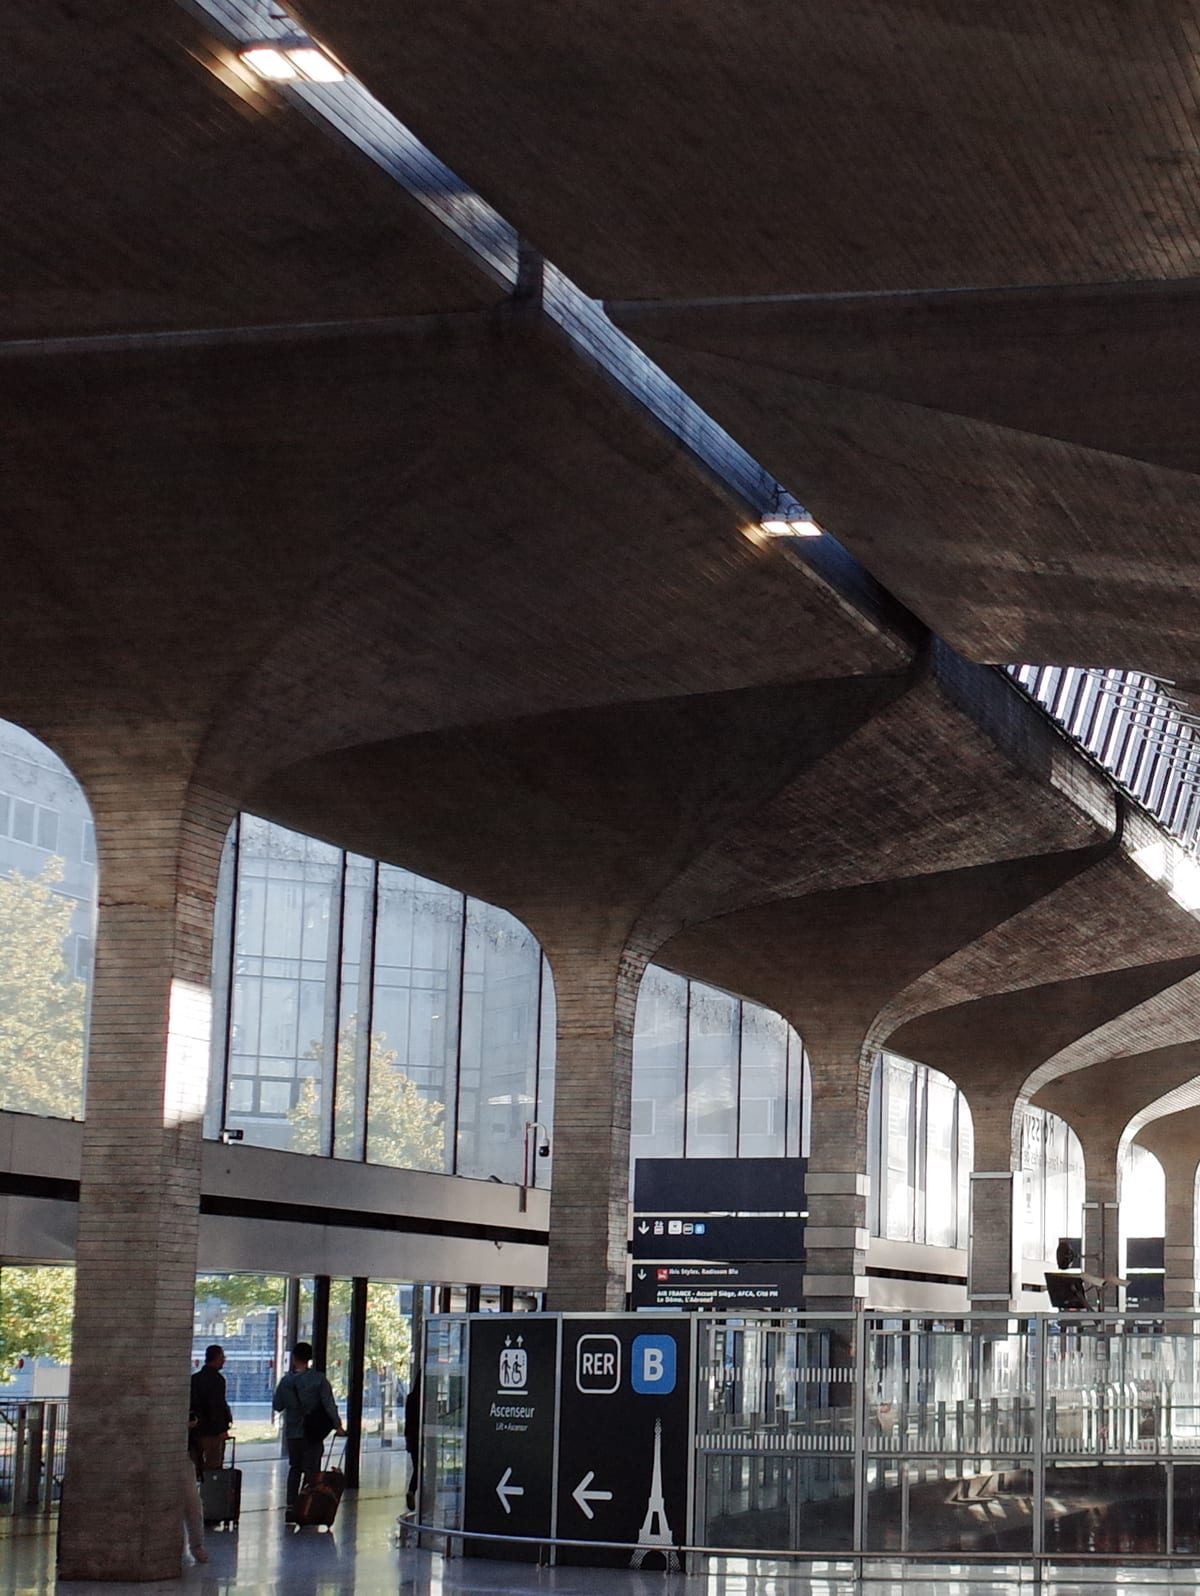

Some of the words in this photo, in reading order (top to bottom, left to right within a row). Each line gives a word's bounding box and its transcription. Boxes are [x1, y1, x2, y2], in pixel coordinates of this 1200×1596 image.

[582, 1353, 615, 1375] RER
[643, 1348, 664, 1382] B
[489, 1402, 536, 1418] Ascenseur
